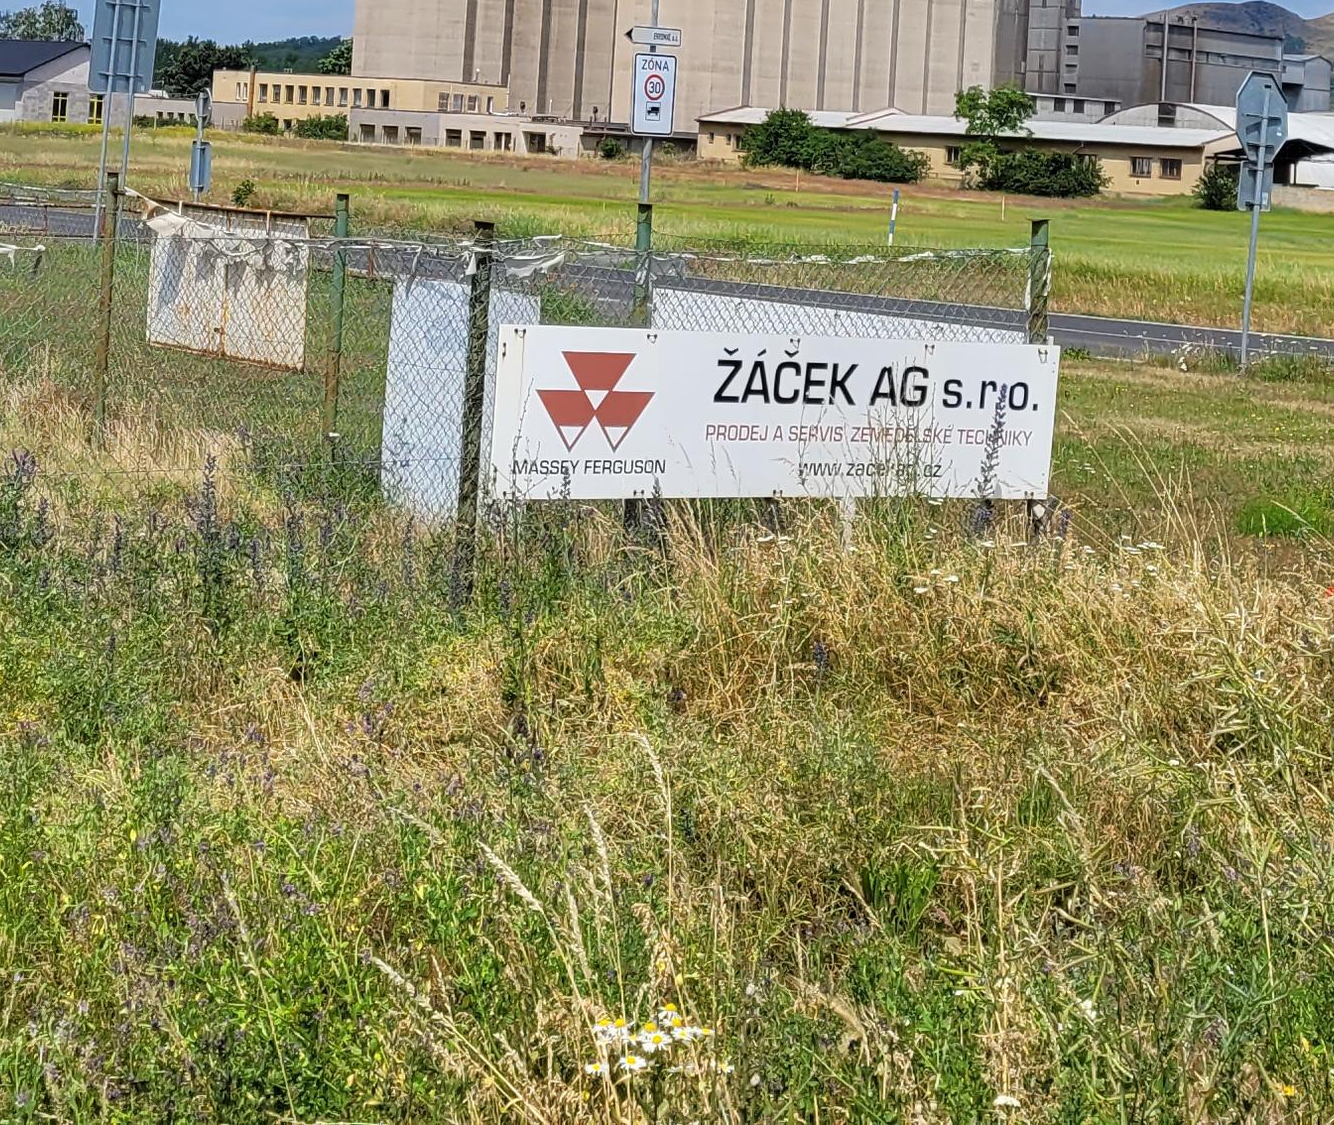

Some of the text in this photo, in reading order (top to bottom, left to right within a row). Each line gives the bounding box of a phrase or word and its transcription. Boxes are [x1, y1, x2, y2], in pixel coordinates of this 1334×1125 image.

[642, 59, 669, 71] ZÓNA
[648, 81, 661, 94] 30
[713, 346, 1039, 412] ŽÁČEK AG s.r.o.
[704, 424, 768, 442] PRODEJ
[772, 425, 784, 442] A
[788, 425, 844, 442] SERVIS
[513, 459, 666, 475] MASSEY FERGUSON
